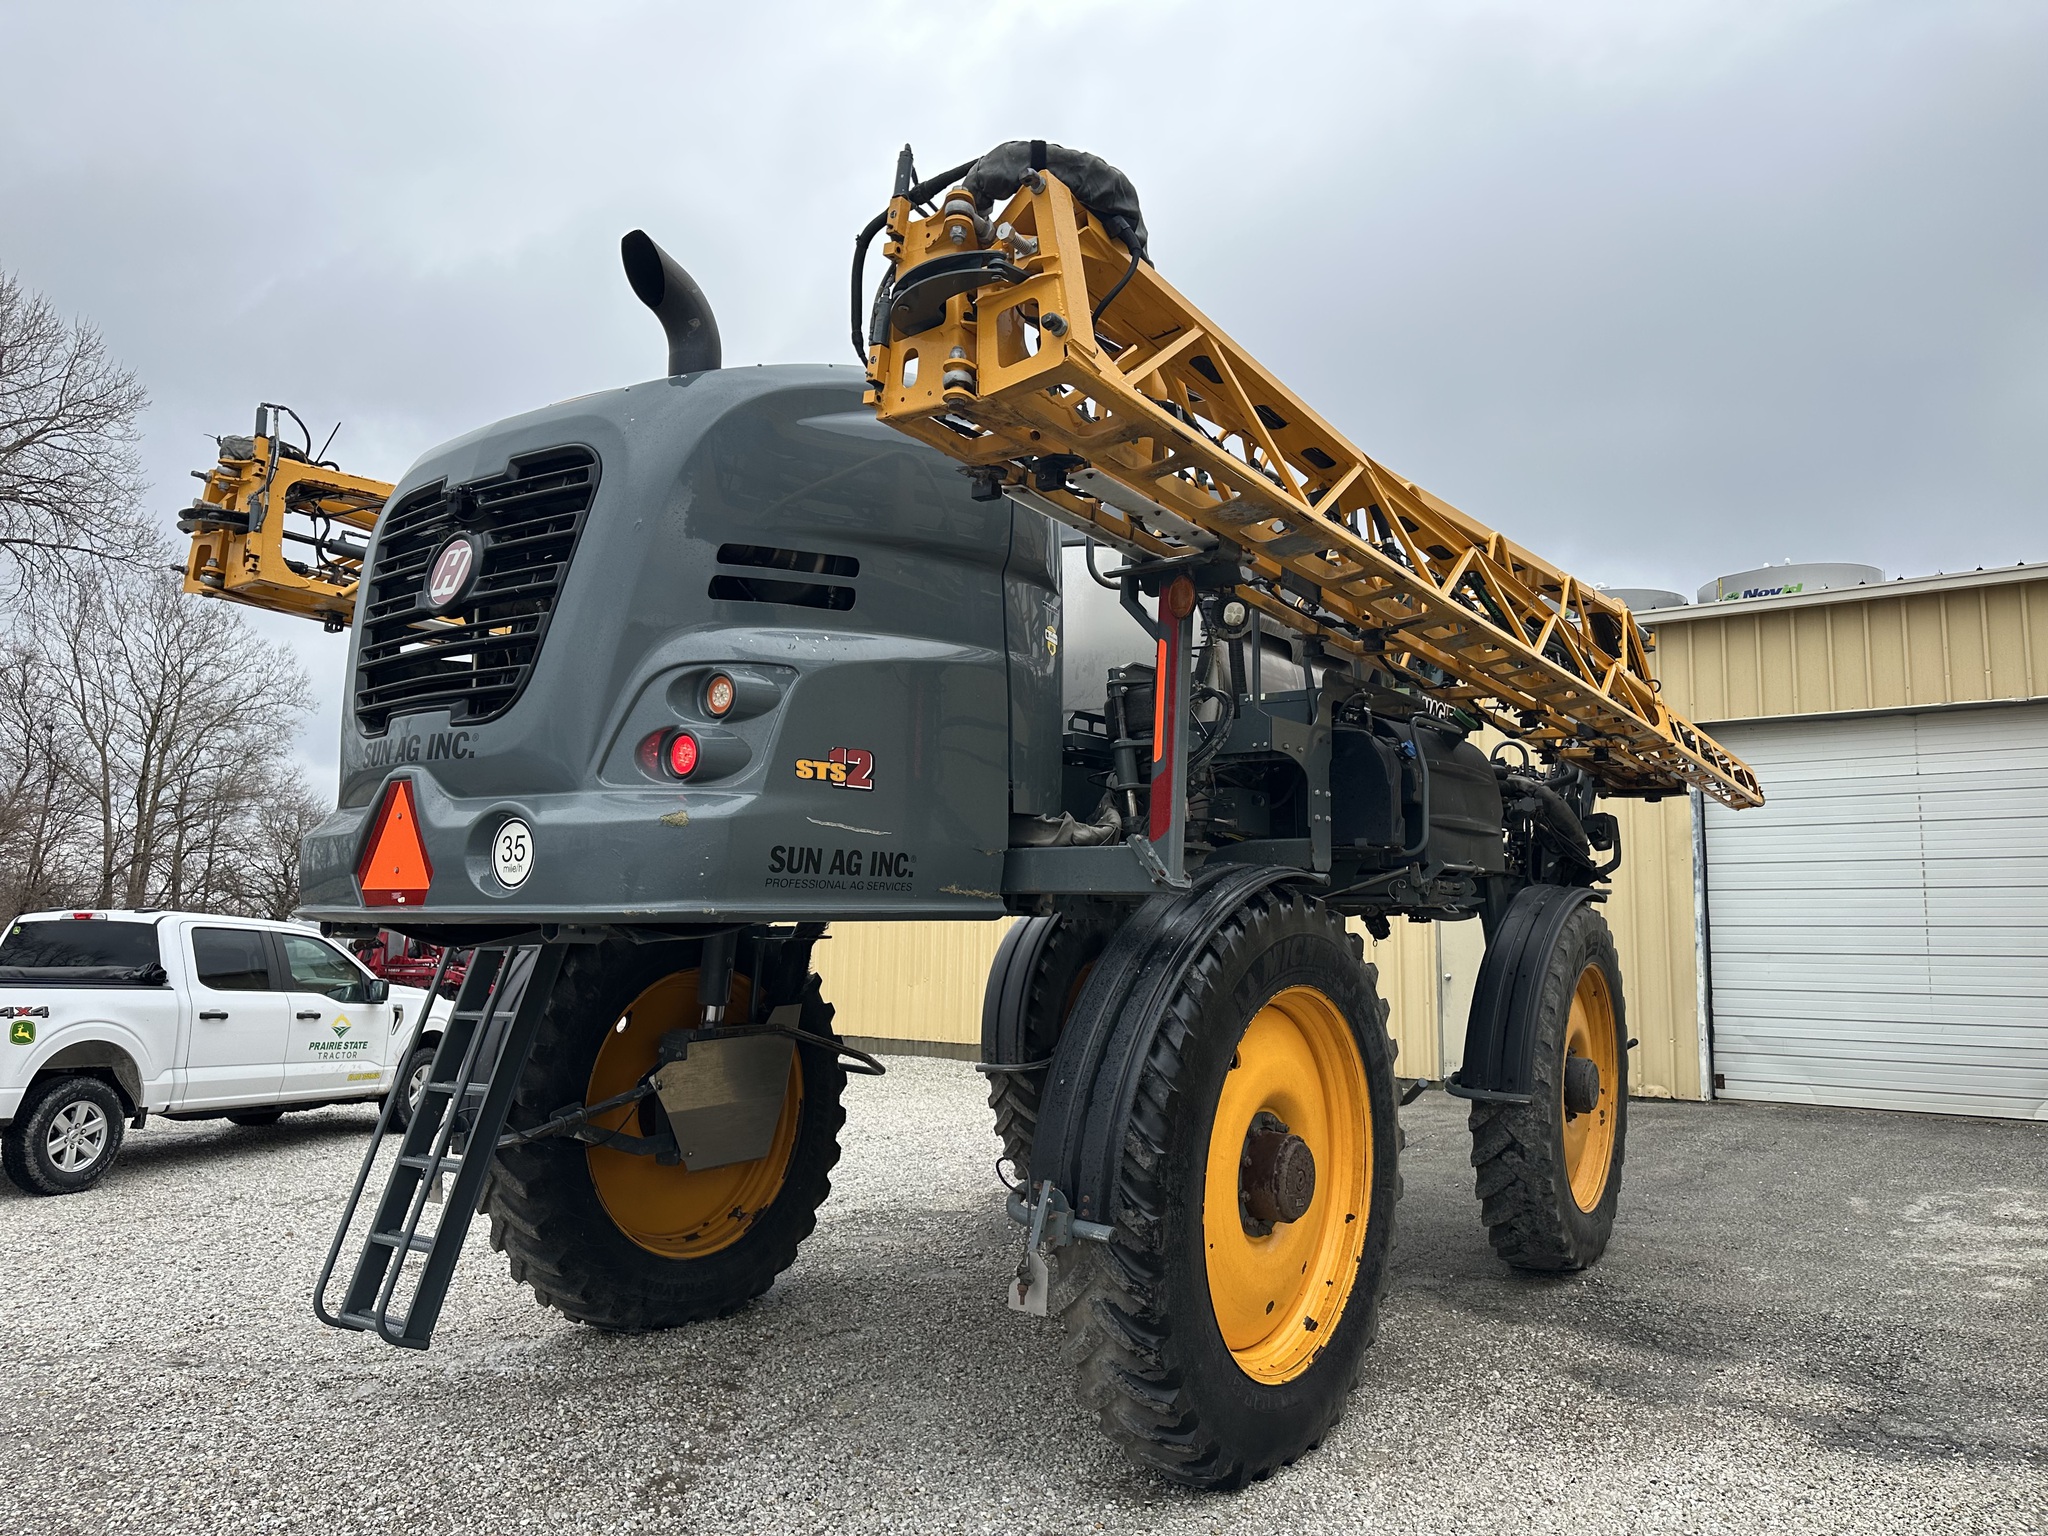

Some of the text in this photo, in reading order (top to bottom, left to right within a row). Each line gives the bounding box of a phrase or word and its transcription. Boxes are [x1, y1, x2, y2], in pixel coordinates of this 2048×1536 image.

[363, 739, 393, 768] SUN
[395, 734, 420, 763] AG
[795, 758, 847, 783] STS
[501, 834, 526, 863] 35
[502, 864, 523, 874] mile/h
[768, 845, 823, 874] SUN
[828, 849, 863, 877] AG
[765, 878, 913, 892] PROFESSIONAL AG SERVICES
[308, 1041, 369, 1051] PRAIRIE STATE
[318, 1051, 358, 1060] TRACTOR
